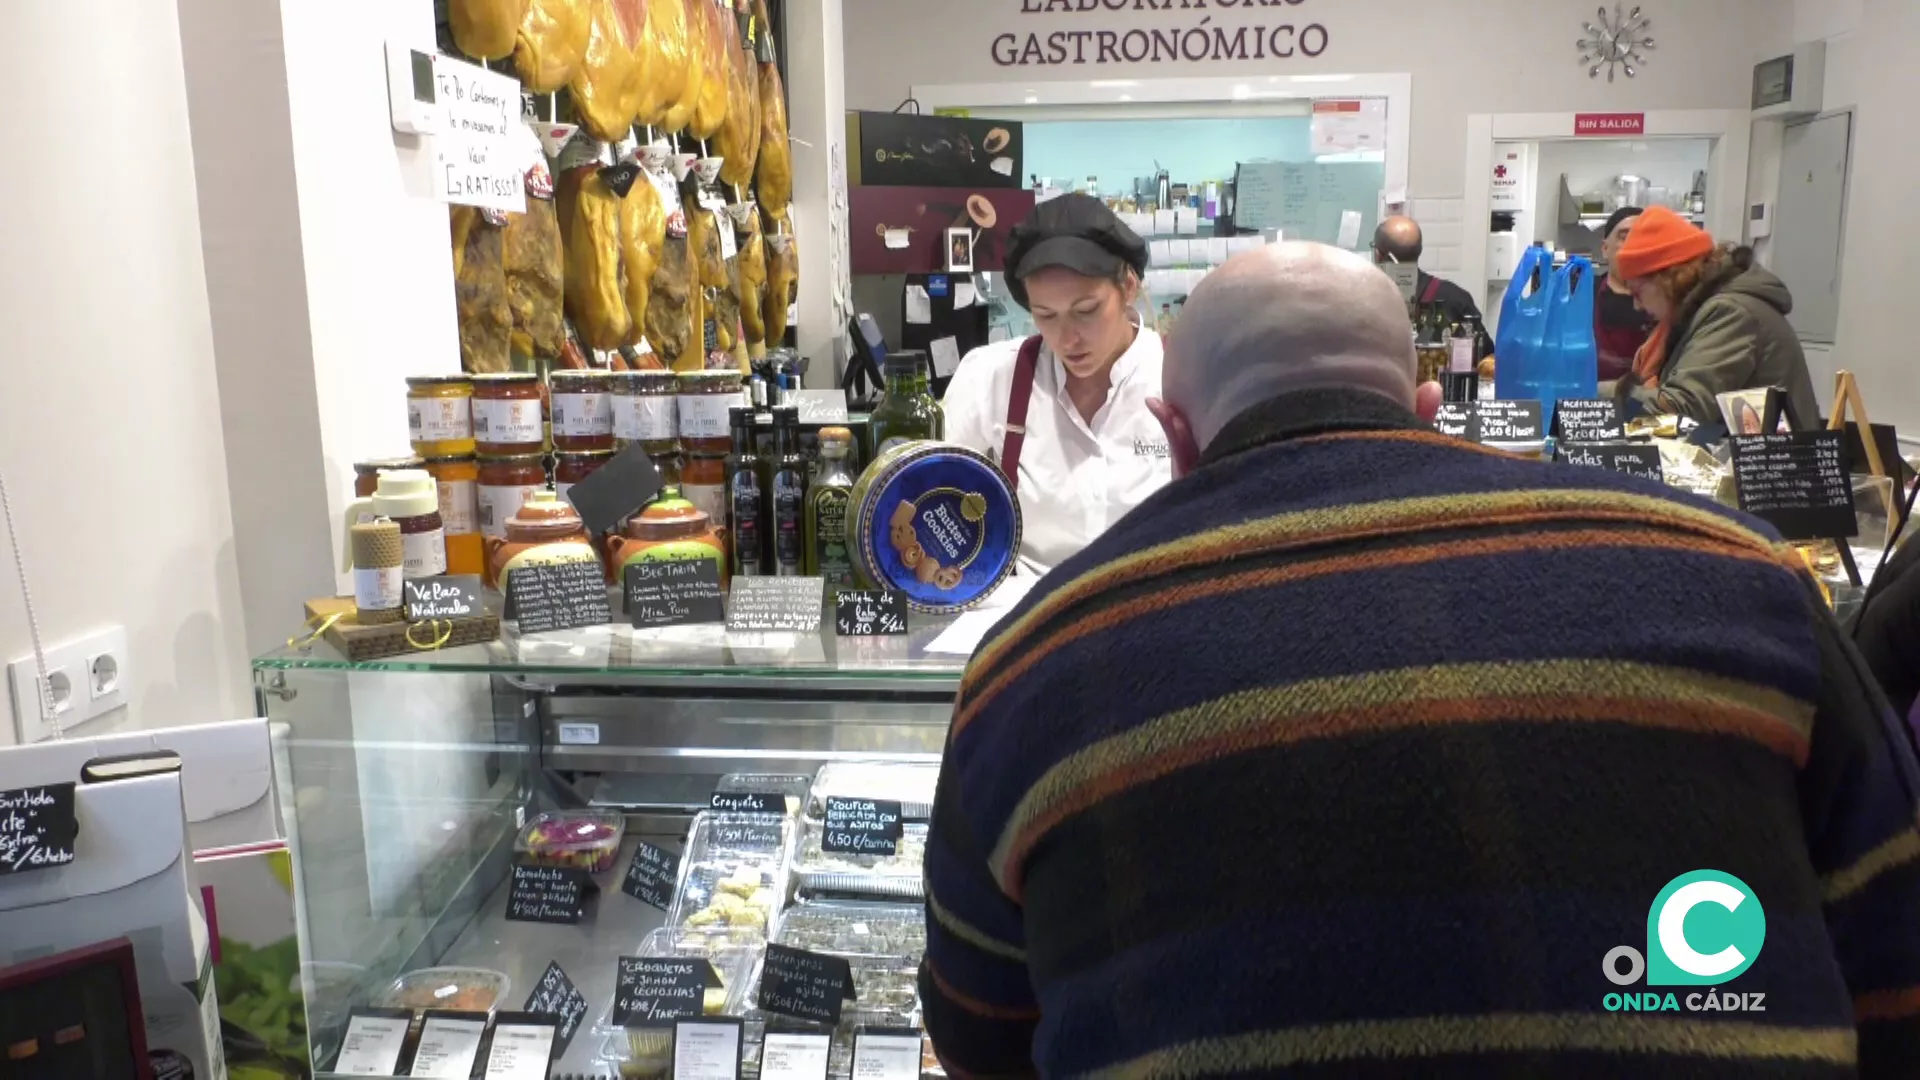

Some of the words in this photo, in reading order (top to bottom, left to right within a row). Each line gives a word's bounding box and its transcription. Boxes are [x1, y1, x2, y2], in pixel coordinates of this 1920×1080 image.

[991, 16, 1329, 66] GASTRONÓMICO
[1578, 120, 1597, 129] SIN
[1599, 119, 1640, 128] SALIDA
[922, 510, 959, 559] Cookies
[934, 503, 967, 546] Butter
